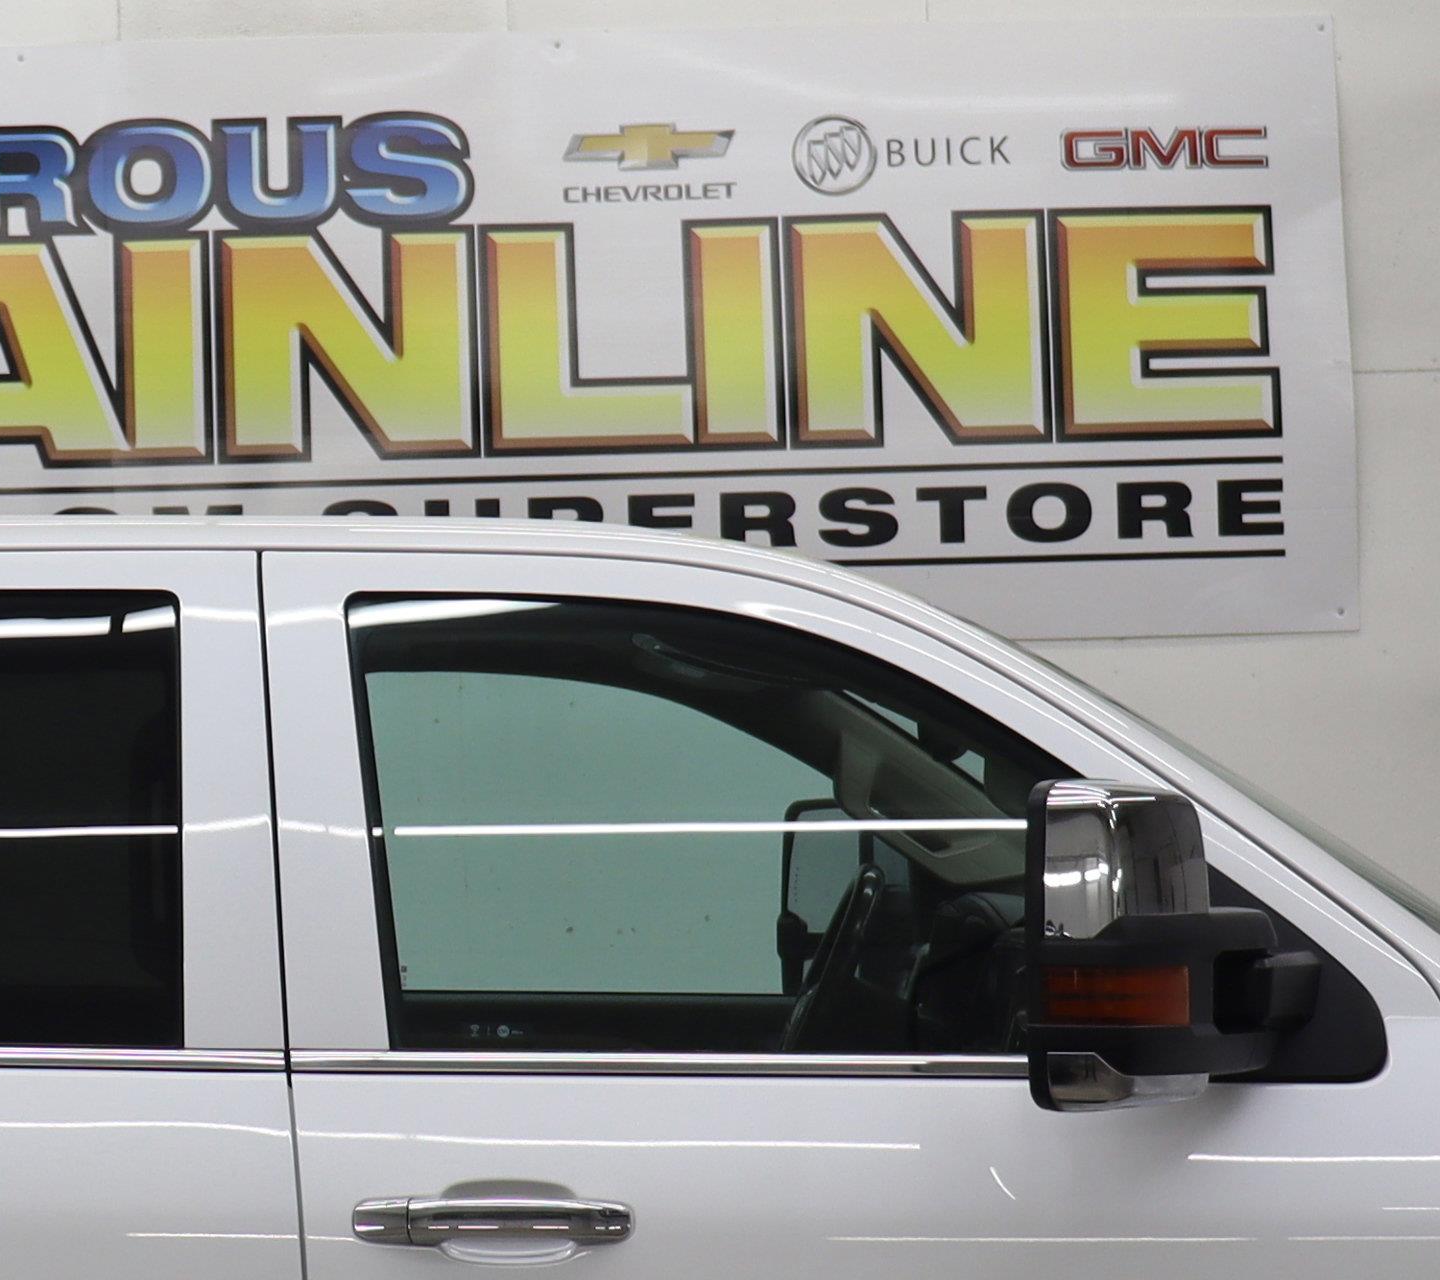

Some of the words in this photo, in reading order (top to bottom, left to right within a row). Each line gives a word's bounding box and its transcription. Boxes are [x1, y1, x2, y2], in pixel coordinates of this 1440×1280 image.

[886, 135, 1012, 168] BUICK
[1060, 125, 1270, 171] GMC
[562, 182, 737, 204] CHEVROLET
[322, 479, 1285, 547] ERSTORE
